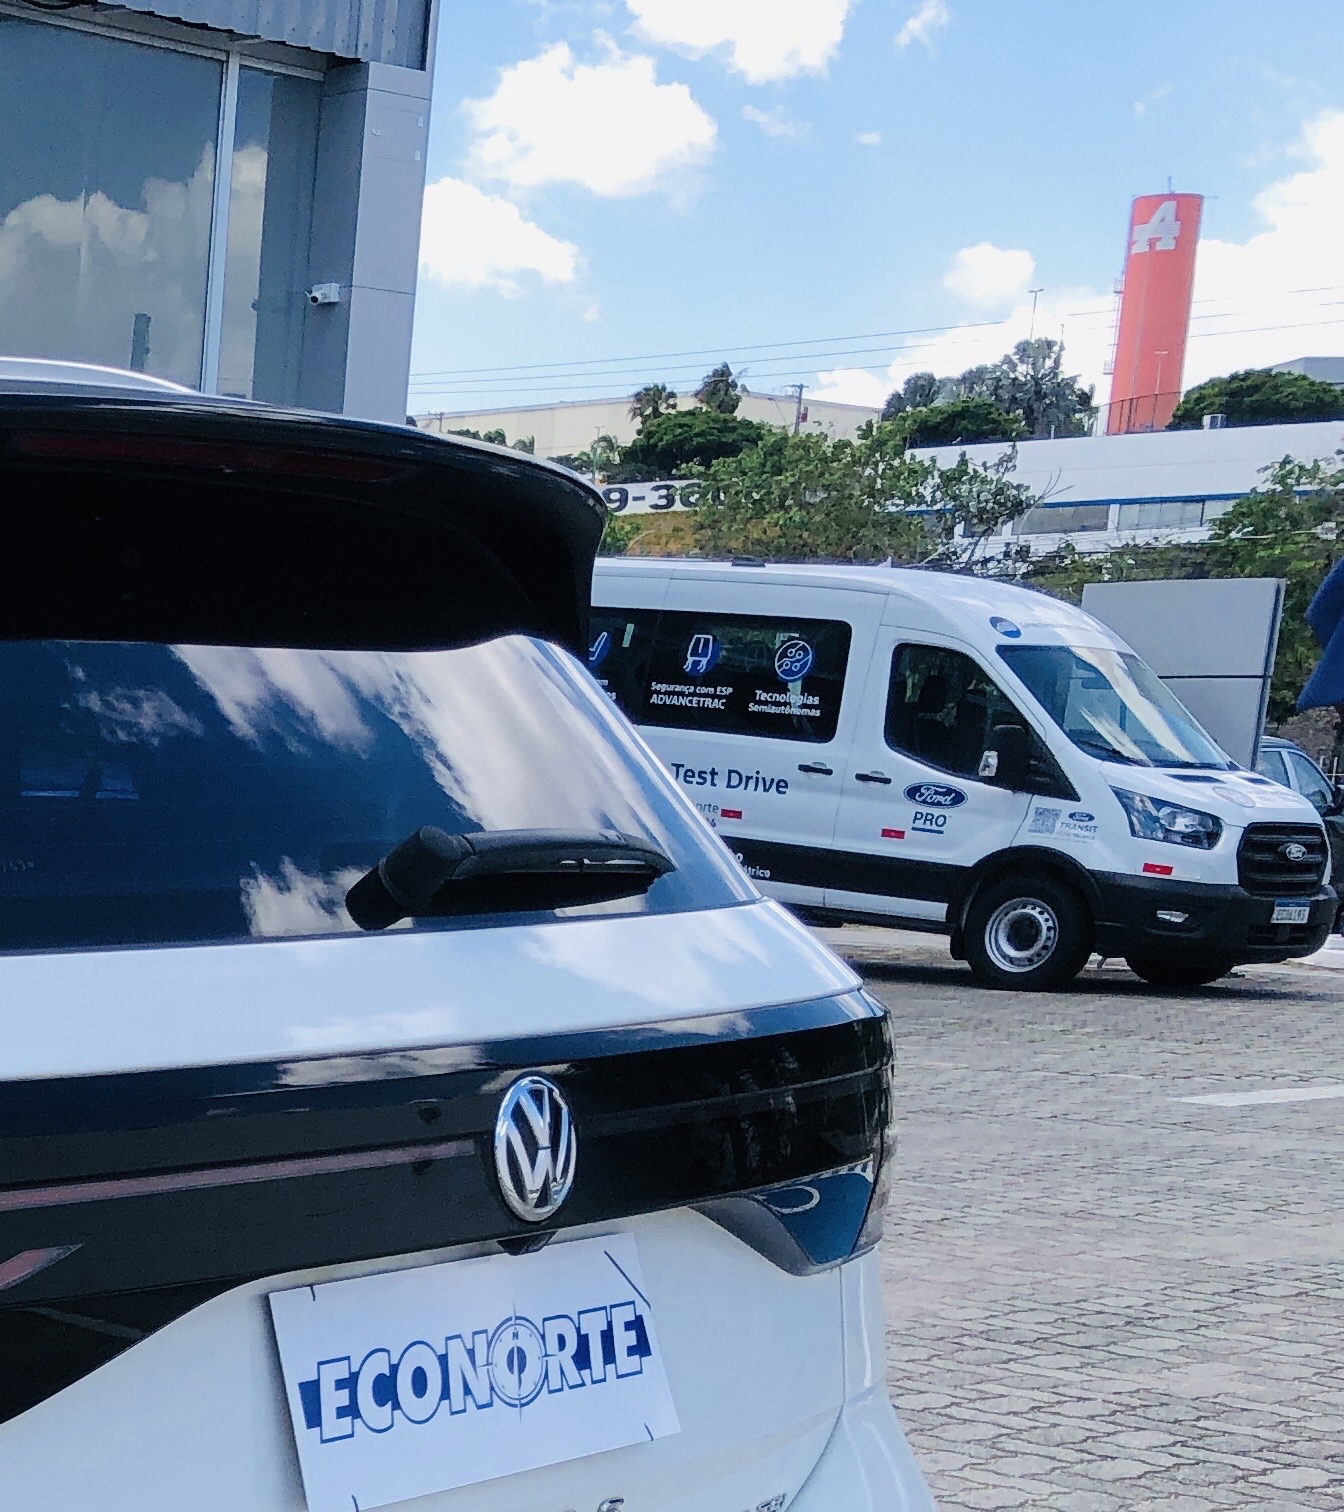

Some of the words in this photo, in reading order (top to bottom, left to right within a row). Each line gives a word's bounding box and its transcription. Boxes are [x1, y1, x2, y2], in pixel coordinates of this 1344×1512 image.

[650, 681, 695, 694] Segurança
[695, 685, 715, 695] com
[716, 685, 733, 696] ESP
[754, 689, 820, 705] Tecnologias
[649, 694, 726, 710] ADVANCETRAC
[748, 702, 821, 717] Semiautônomas
[671, 763, 718, 787] Test
[725, 768, 789, 795] Drive
[913, 785, 958, 806] Ford
[912, 810, 948, 828] PRO
[316, 1301, 646, 1444] ECONORTE
